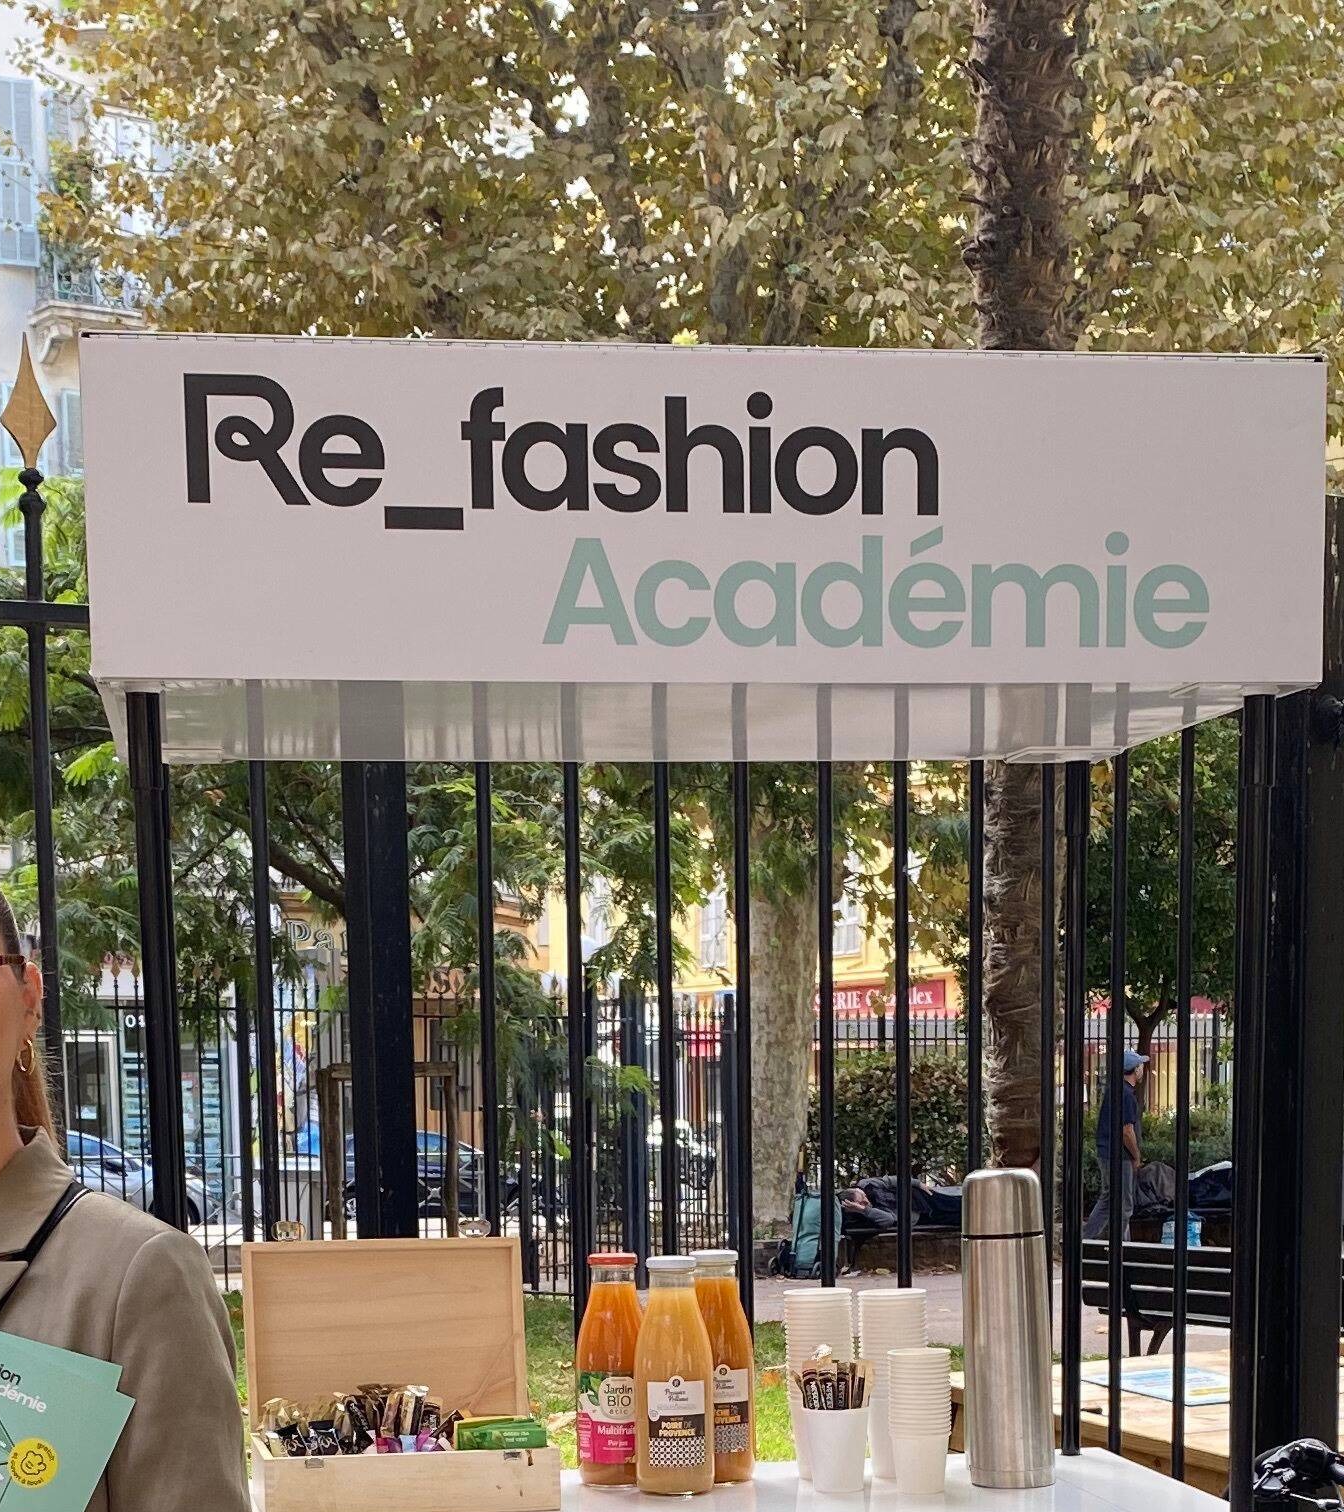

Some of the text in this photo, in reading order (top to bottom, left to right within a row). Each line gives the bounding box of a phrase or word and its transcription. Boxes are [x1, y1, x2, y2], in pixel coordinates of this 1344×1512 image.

[182, 372, 940, 530] Re_fashion
[541, 525, 1210, 650] Académie
[603, 1383, 633, 1396] Jardin
